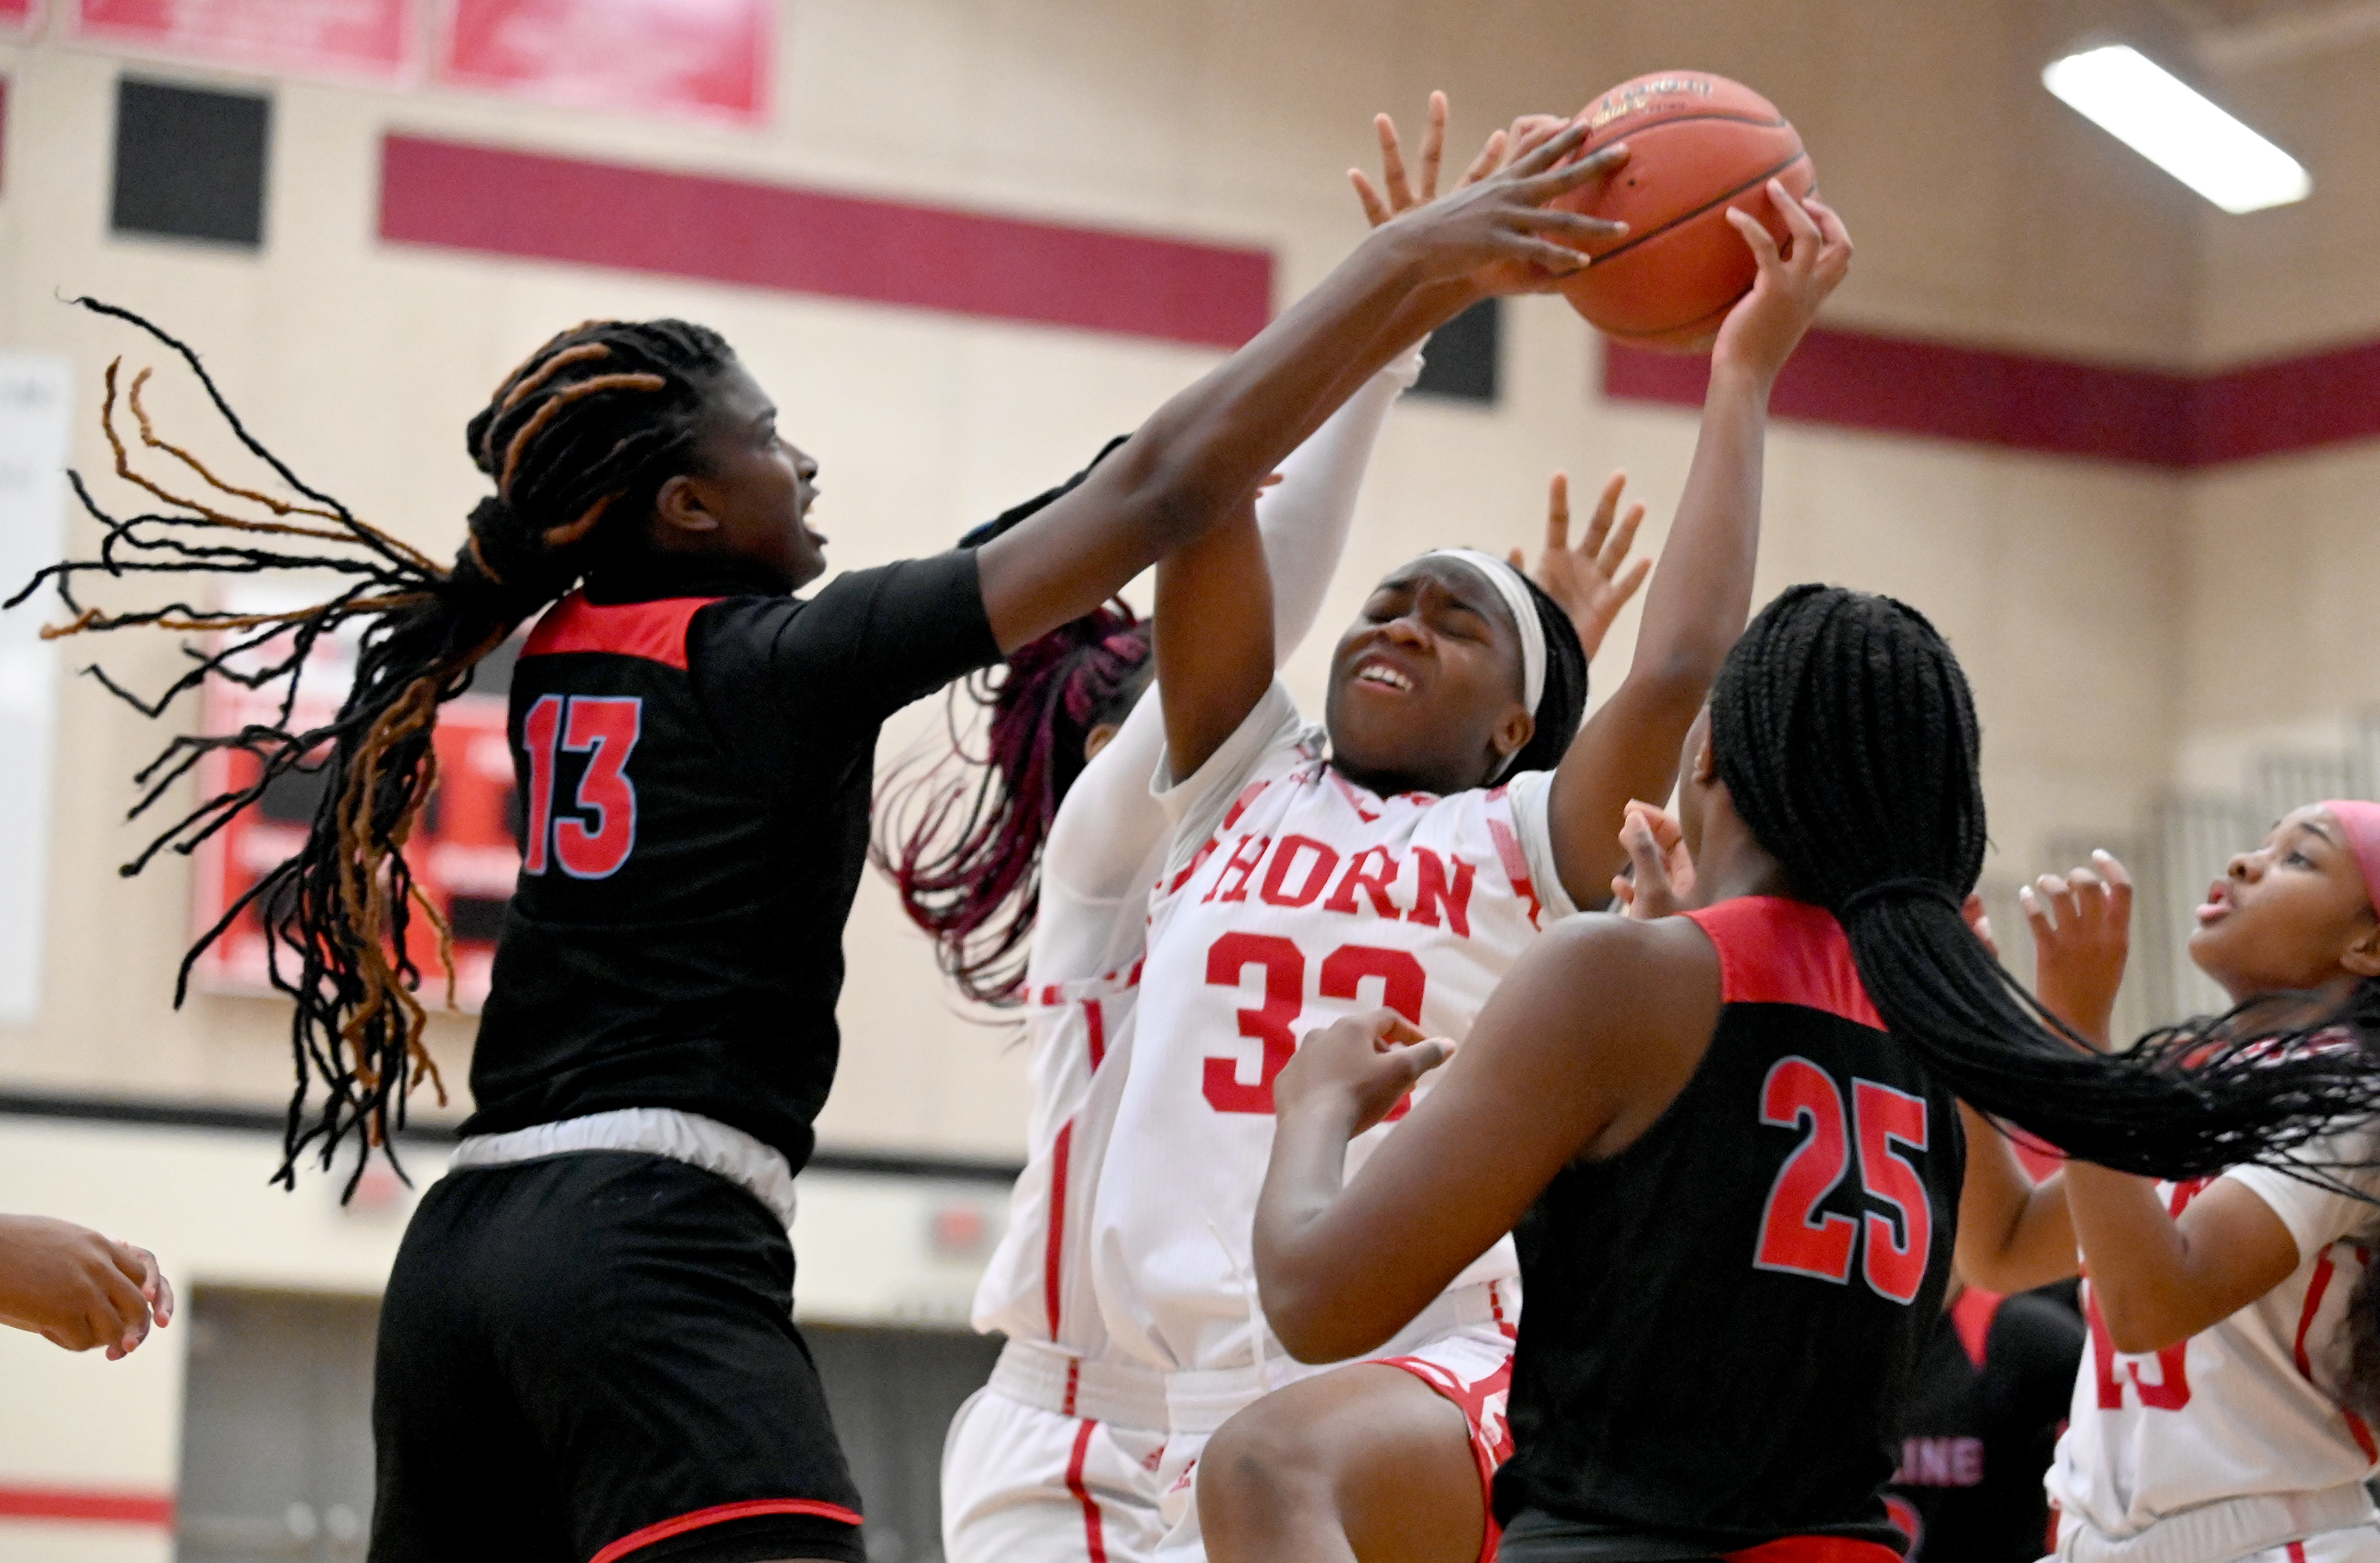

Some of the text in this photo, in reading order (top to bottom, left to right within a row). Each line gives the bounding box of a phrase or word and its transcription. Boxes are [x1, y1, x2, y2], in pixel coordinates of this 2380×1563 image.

[523, 693, 643, 880] 13
[1199, 830, 1476, 939] HORN
[1752, 1054, 1933, 1306] 25
